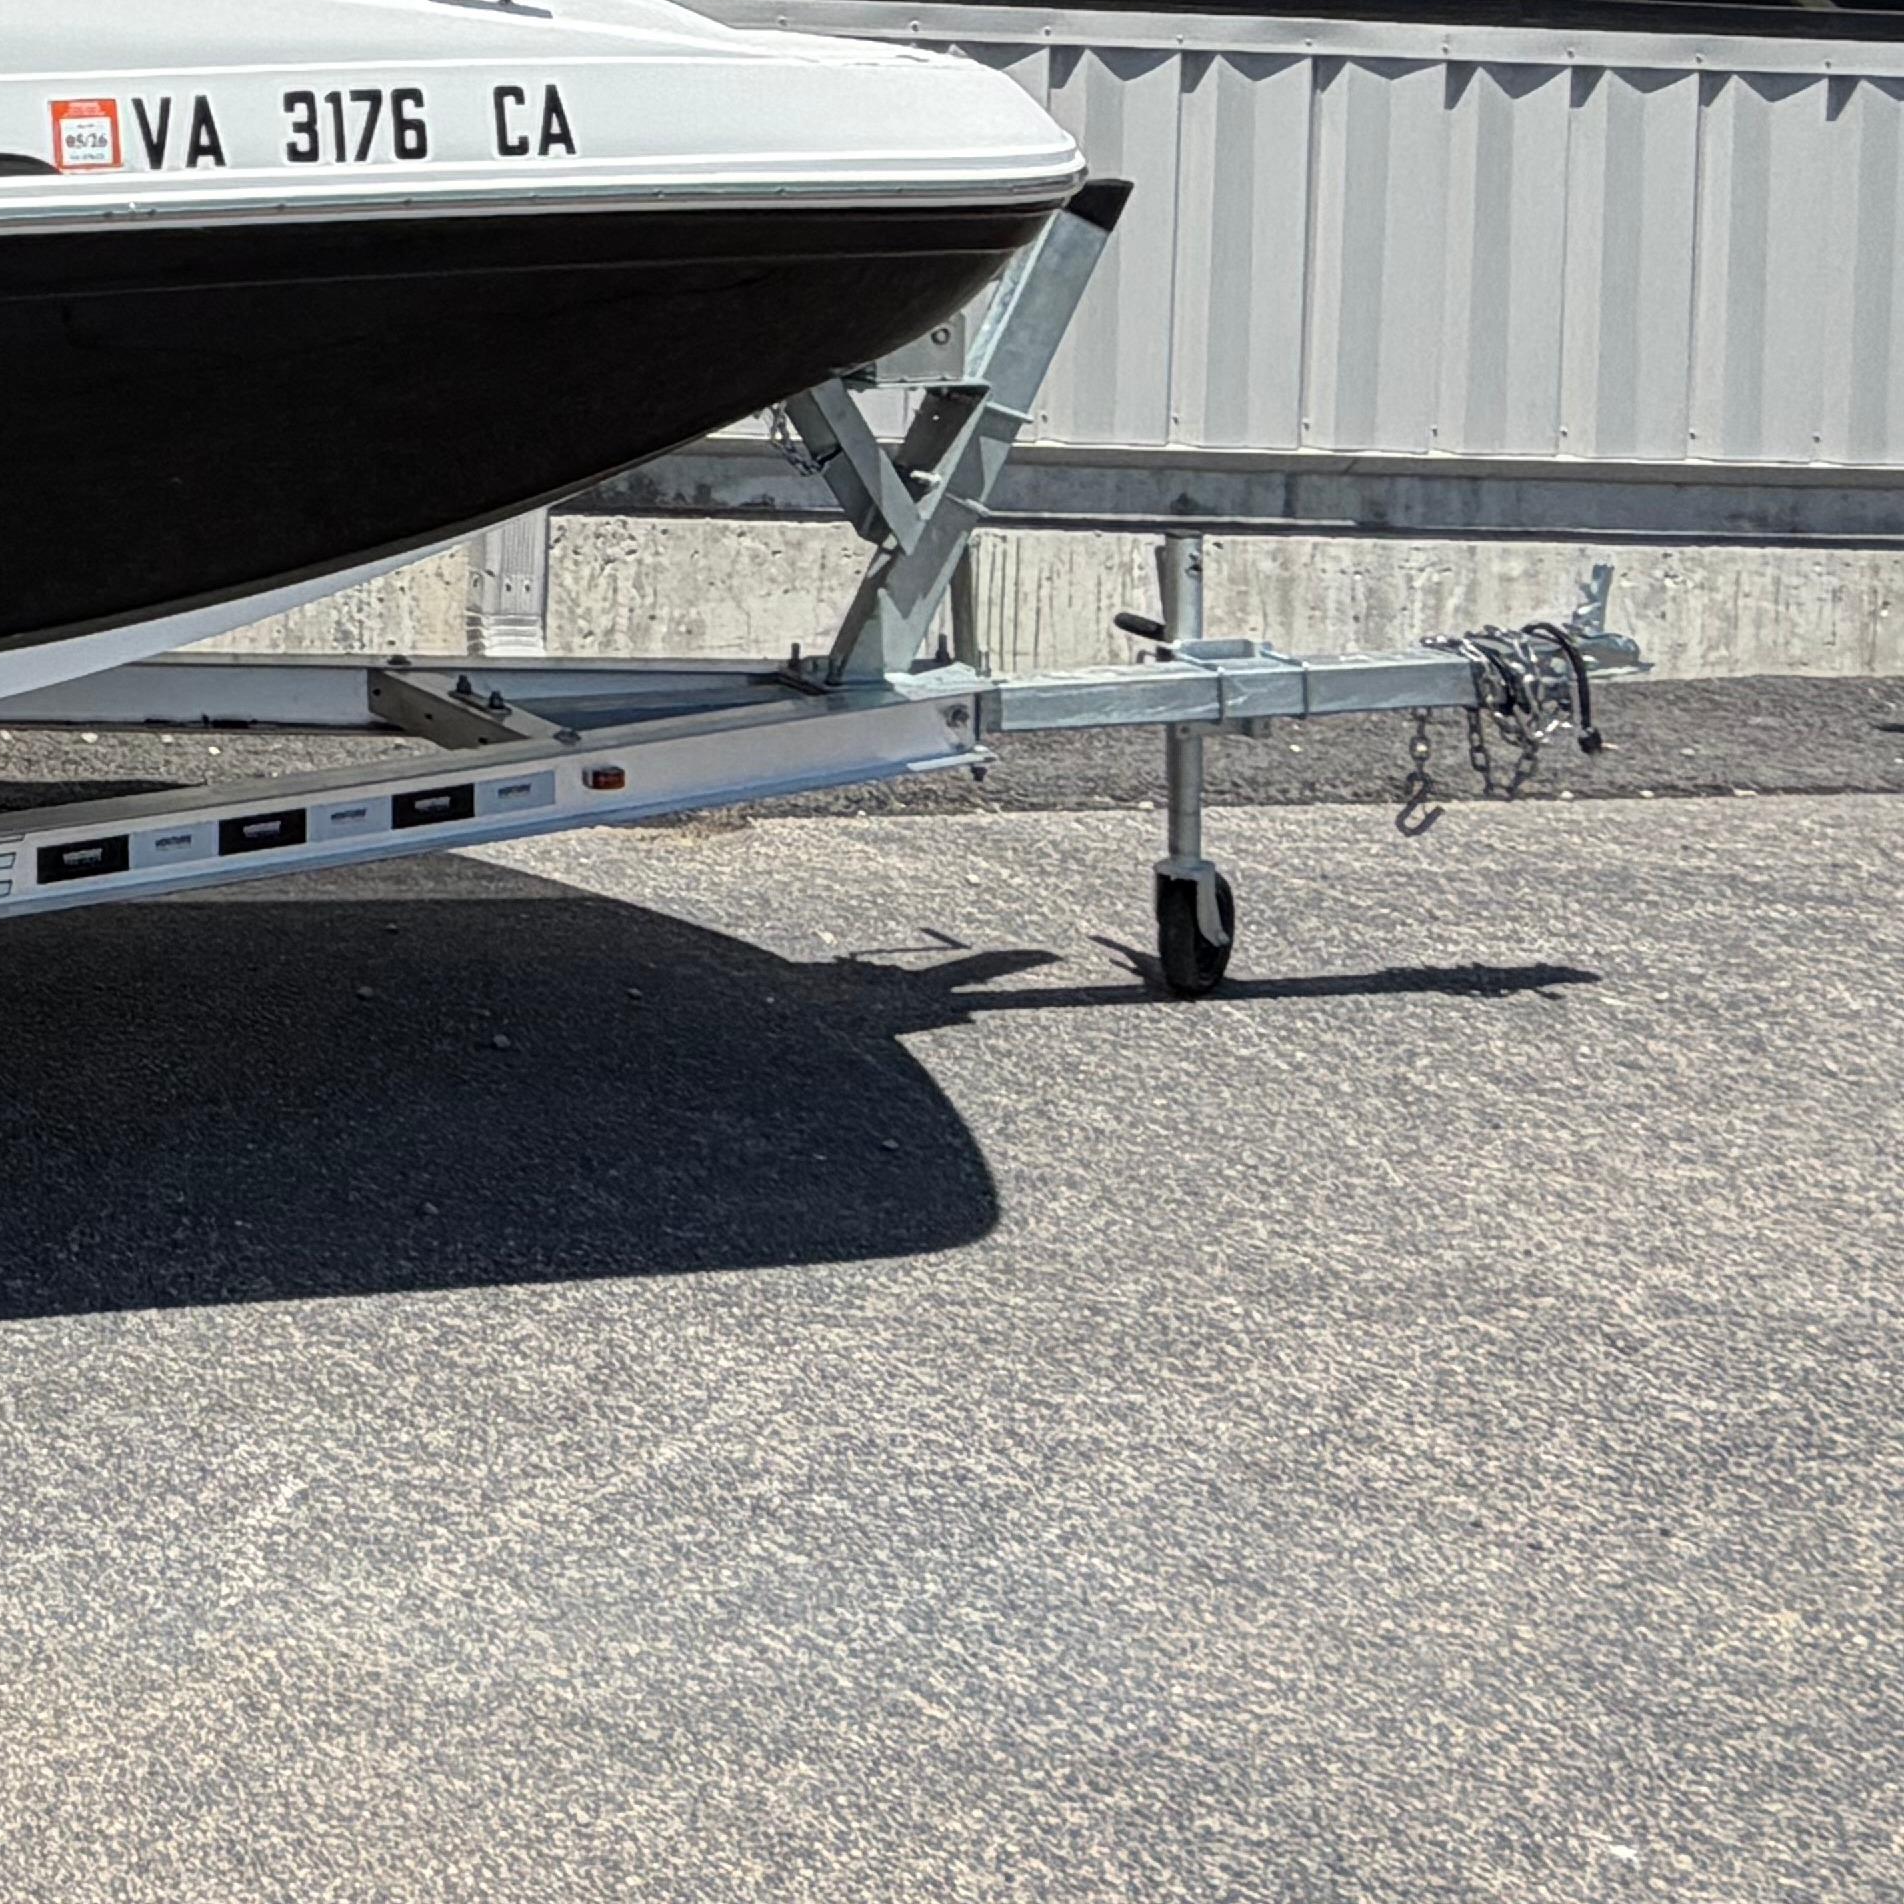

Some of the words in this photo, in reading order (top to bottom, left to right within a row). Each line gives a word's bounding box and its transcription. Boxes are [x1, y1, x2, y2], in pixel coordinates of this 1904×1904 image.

[132, 94, 227, 169] VA
[284, 87, 428, 162] 3176
[493, 84, 576, 156] CA
